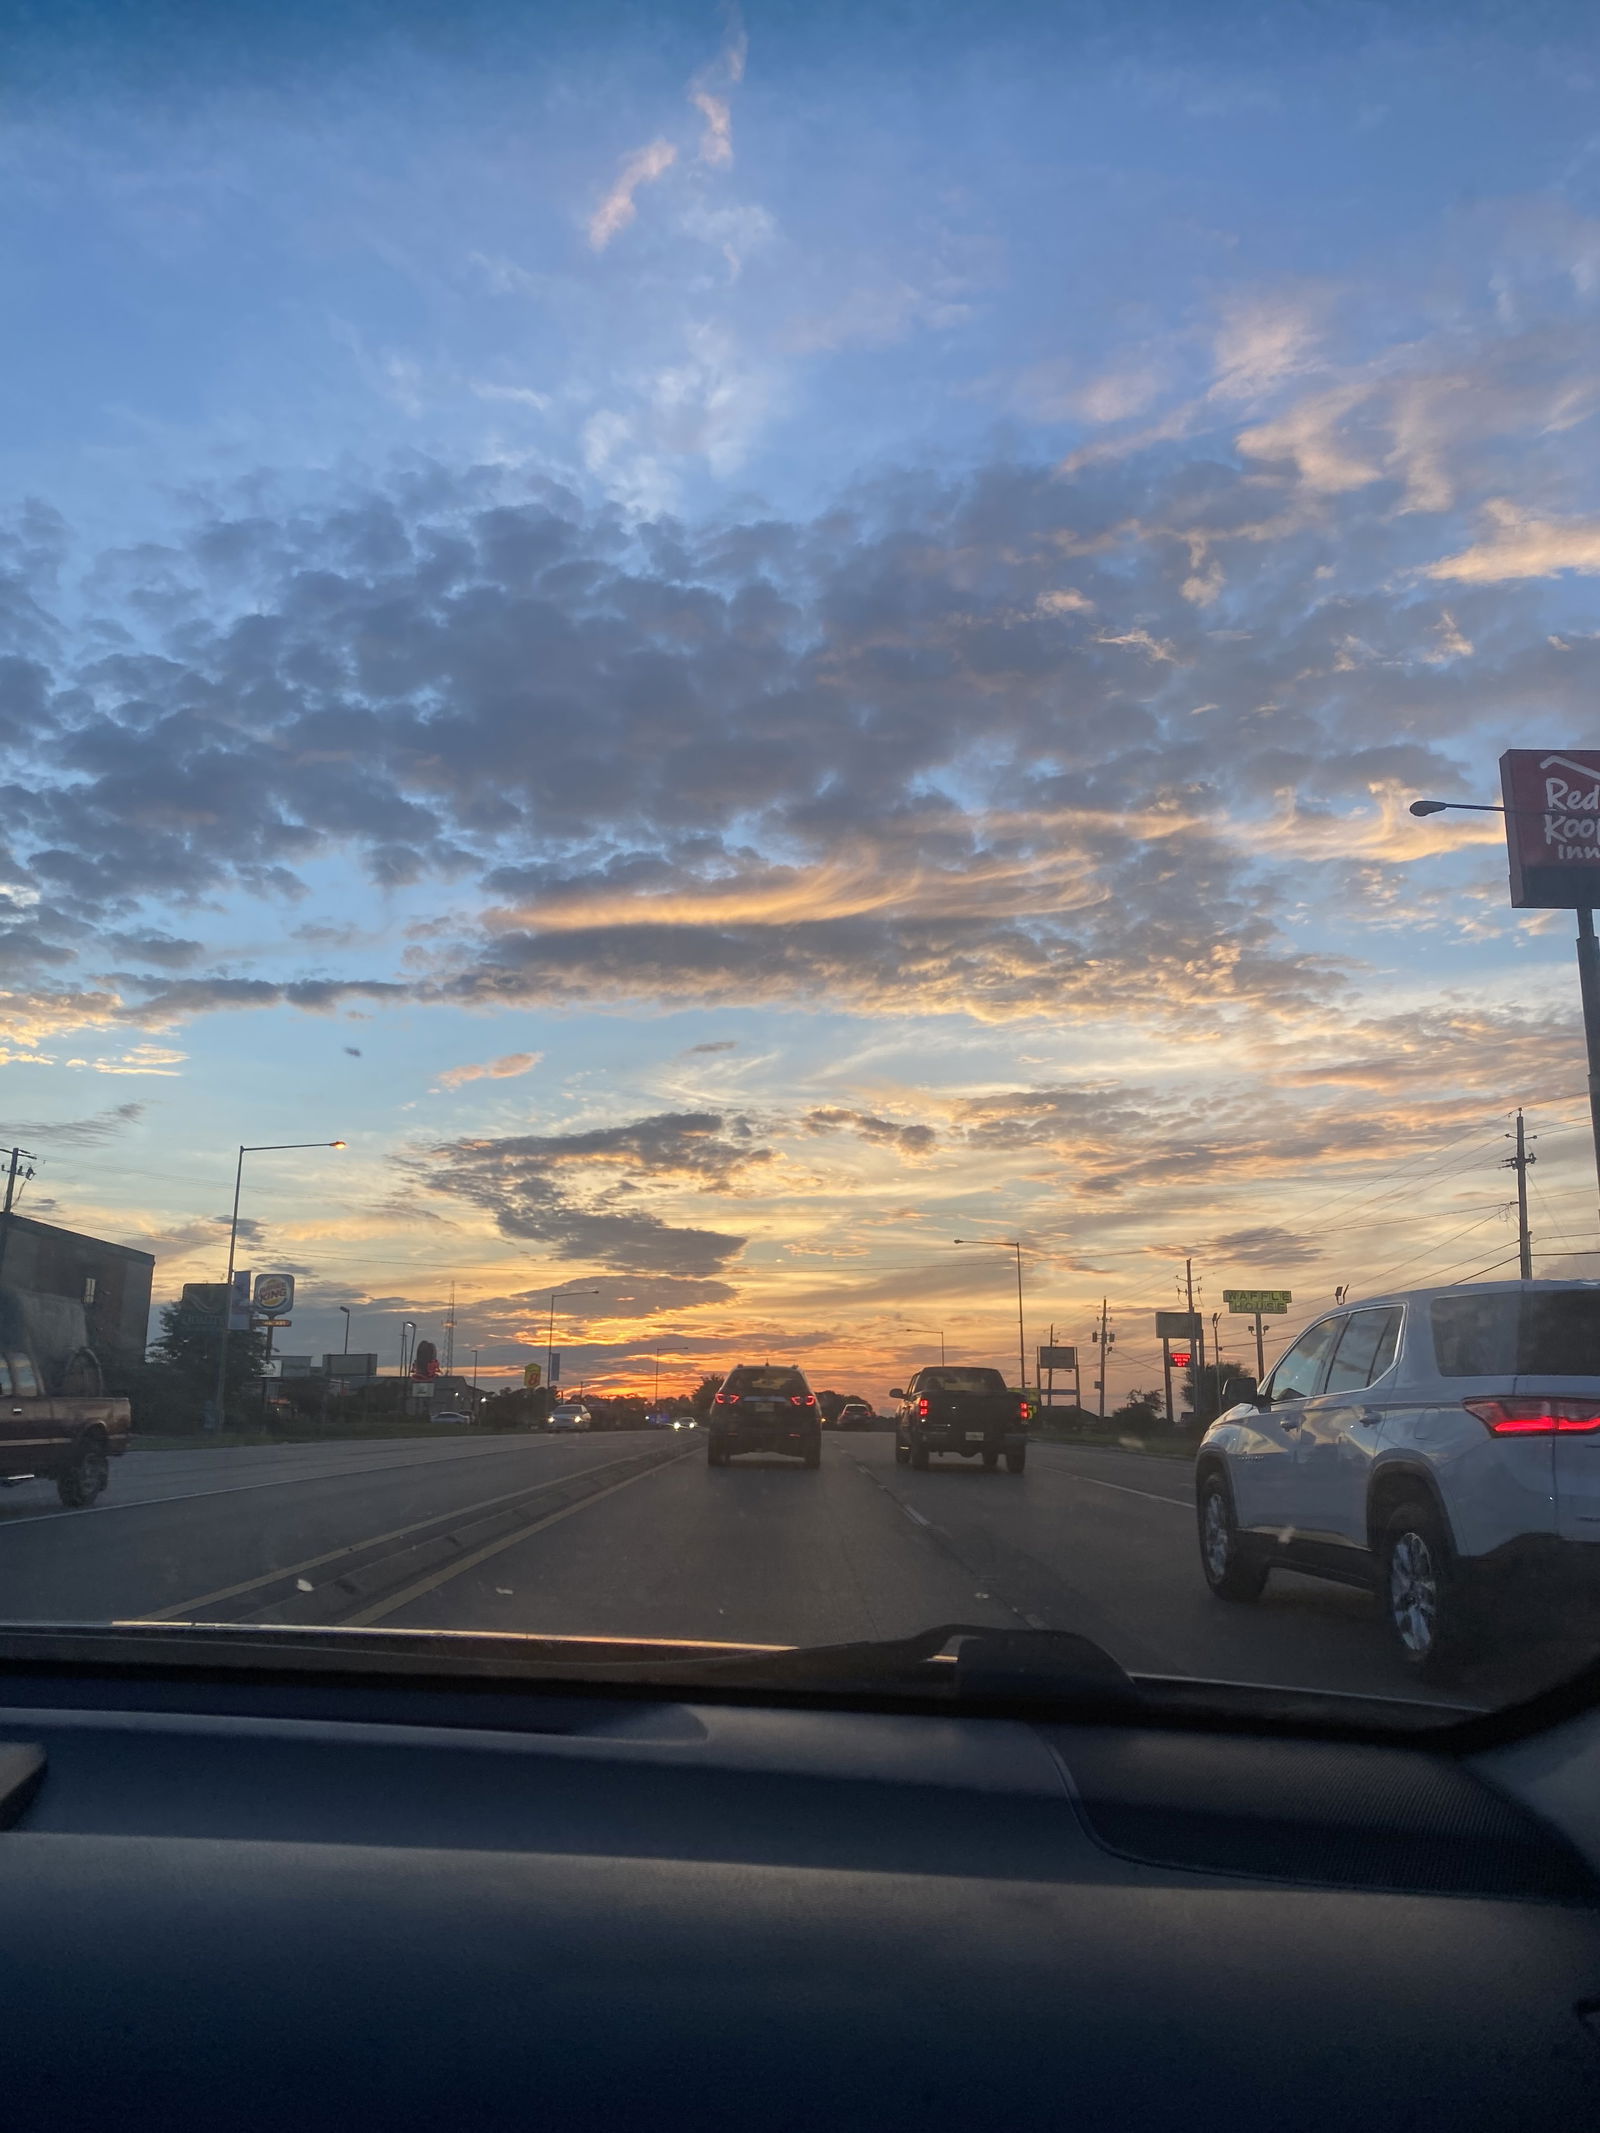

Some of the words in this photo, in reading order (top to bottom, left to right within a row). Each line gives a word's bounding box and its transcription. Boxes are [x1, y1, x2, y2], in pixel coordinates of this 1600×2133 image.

[1546, 778, 1600, 810] Red
[1544, 809, 1600, 845] Roo
[1558, 845, 1600, 860] Inn
[1227, 1291, 1290, 1301] WAFFLE
[1234, 1302, 1287, 1311] HOUSE
